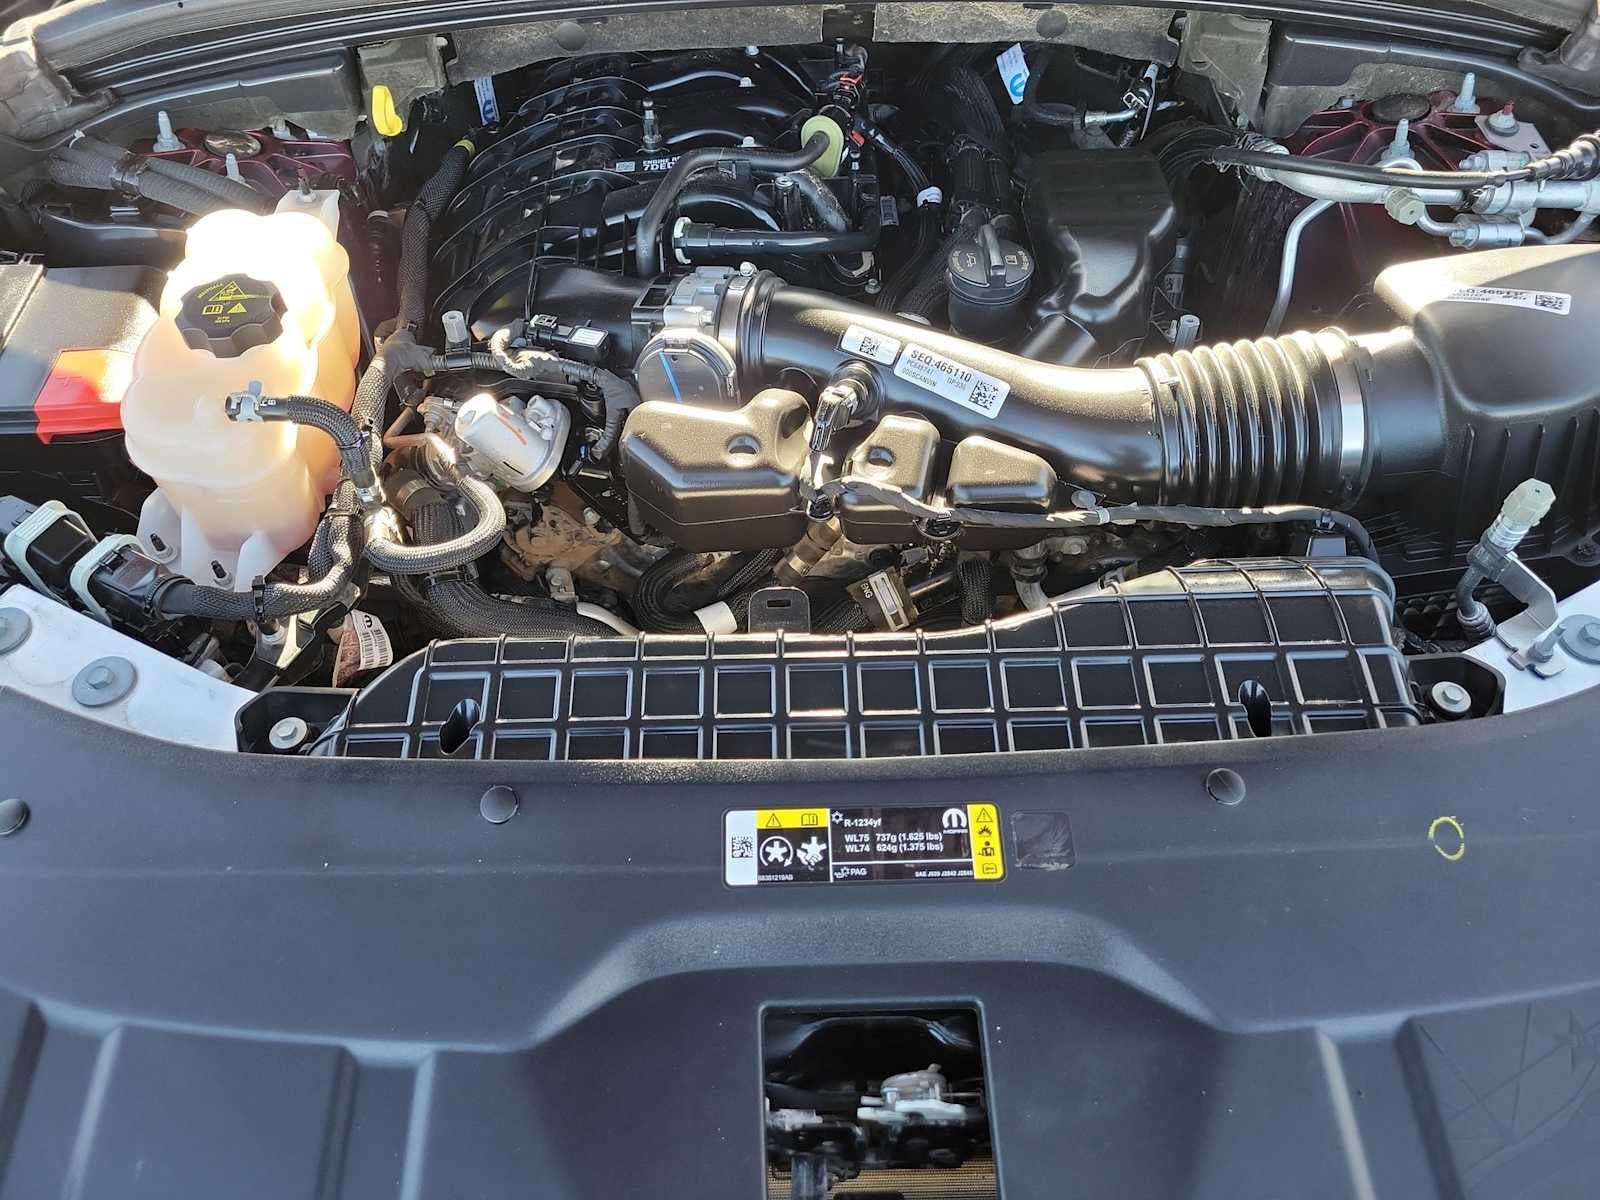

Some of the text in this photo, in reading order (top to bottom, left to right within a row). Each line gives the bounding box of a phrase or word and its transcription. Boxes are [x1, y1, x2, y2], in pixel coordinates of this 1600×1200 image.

[910, 349, 972, 383] SEQ:465110
[843, 817, 882, 829] R-1234yf
[844, 832, 943, 843] WL75 737g (1.625 lbs)
[845, 842, 944, 854] WL74 624g (1.375 lbs)
[850, 868, 867, 876] PAG
